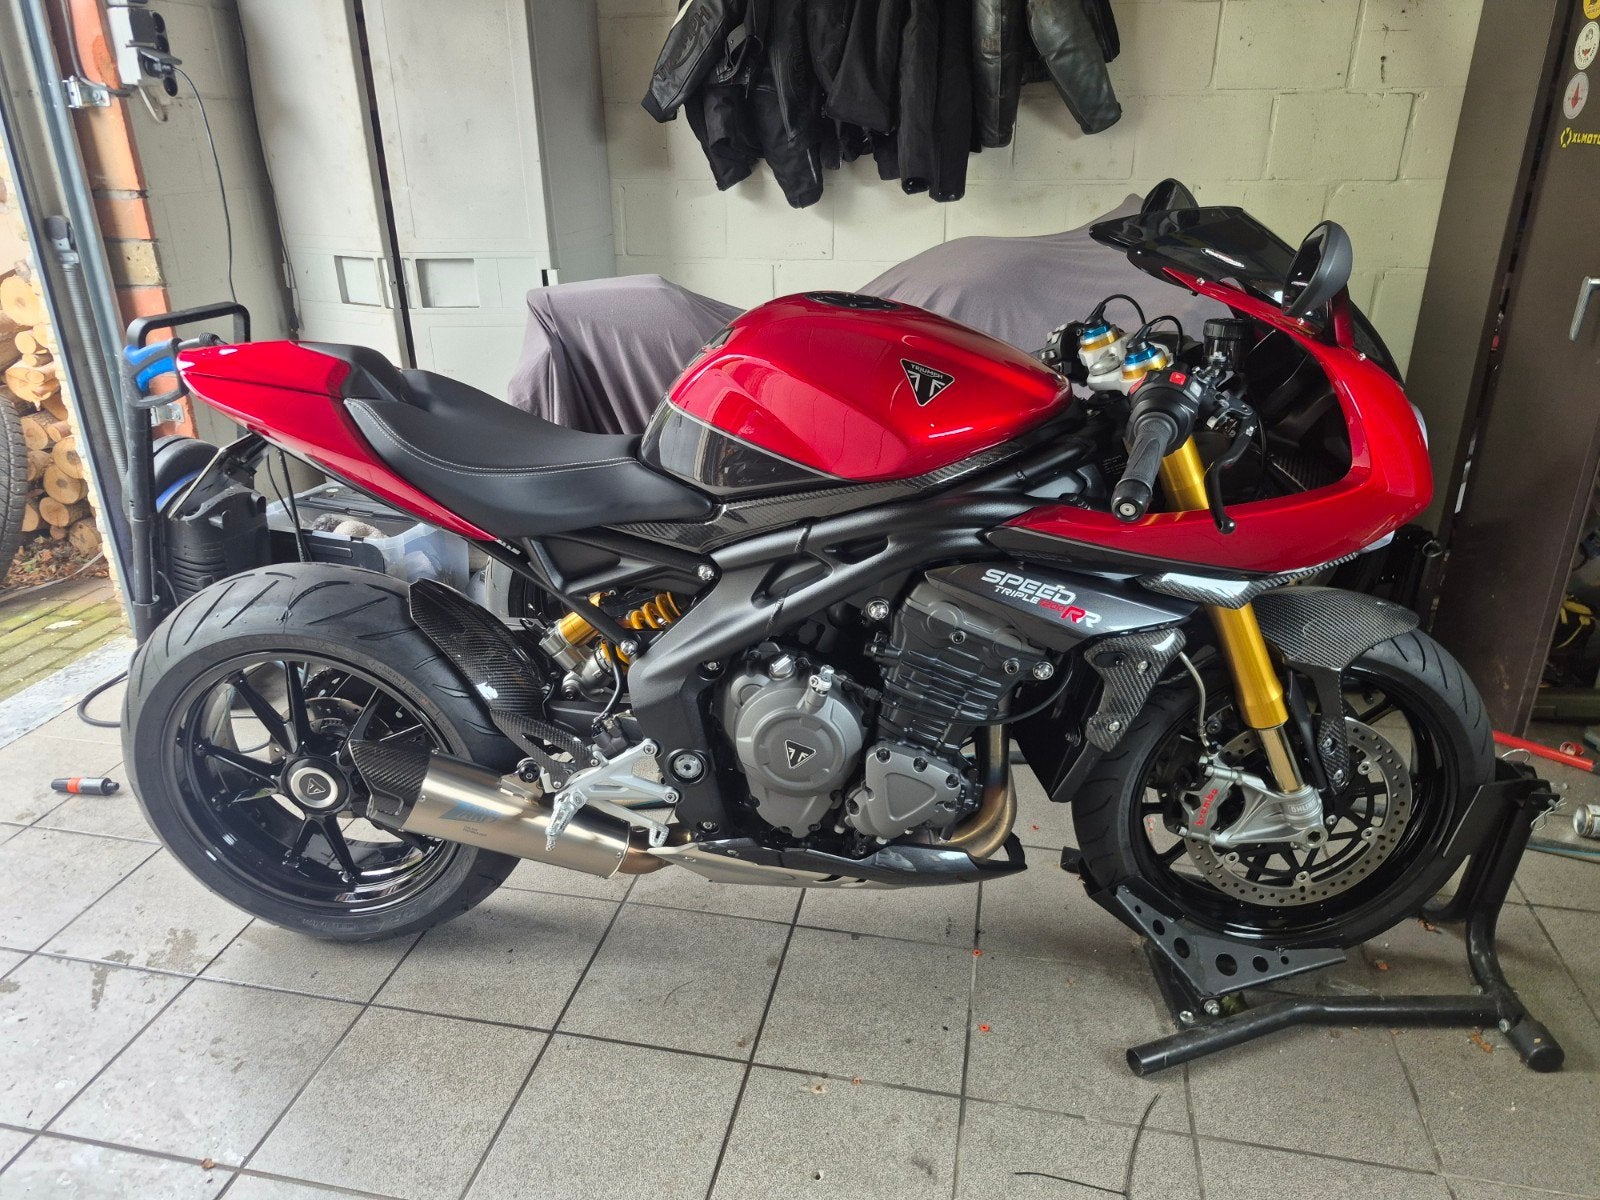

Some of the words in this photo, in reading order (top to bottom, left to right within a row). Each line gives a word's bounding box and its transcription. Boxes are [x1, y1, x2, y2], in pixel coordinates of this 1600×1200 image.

[911, 364, 943, 379] TRIUMPH
[981, 568, 1077, 606] SPEED
[994, 585, 1041, 605] TRIPLE
[1194, 788, 1219, 826] brembo
